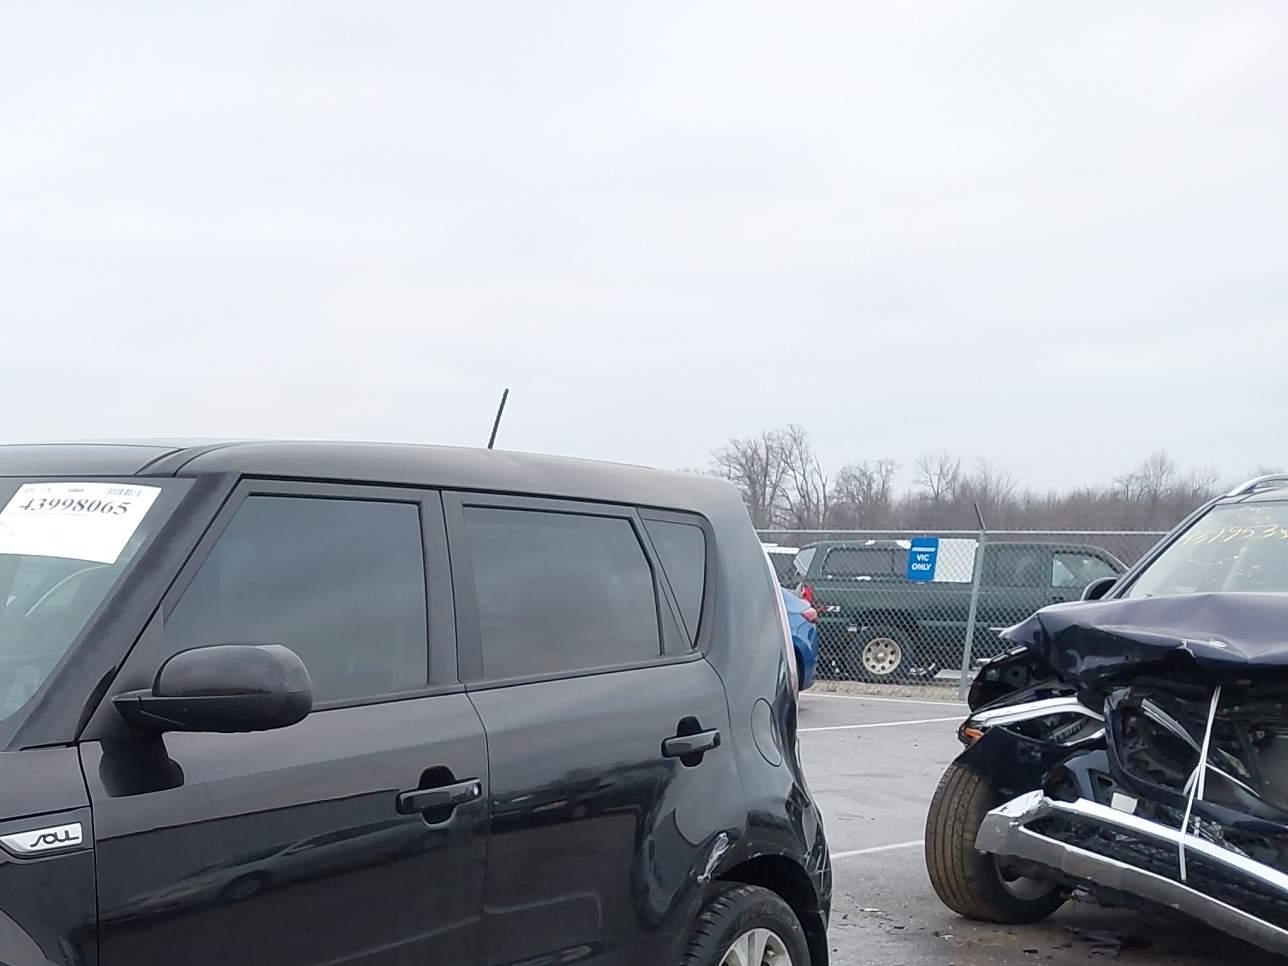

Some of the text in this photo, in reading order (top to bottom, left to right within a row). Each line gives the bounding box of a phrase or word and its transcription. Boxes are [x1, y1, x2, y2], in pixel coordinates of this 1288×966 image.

[19, 497, 132, 516] 43998065
[916, 553, 930, 562] VIC
[911, 562, 932, 571] ONLY
[29, 829, 80, 848] SOUL
